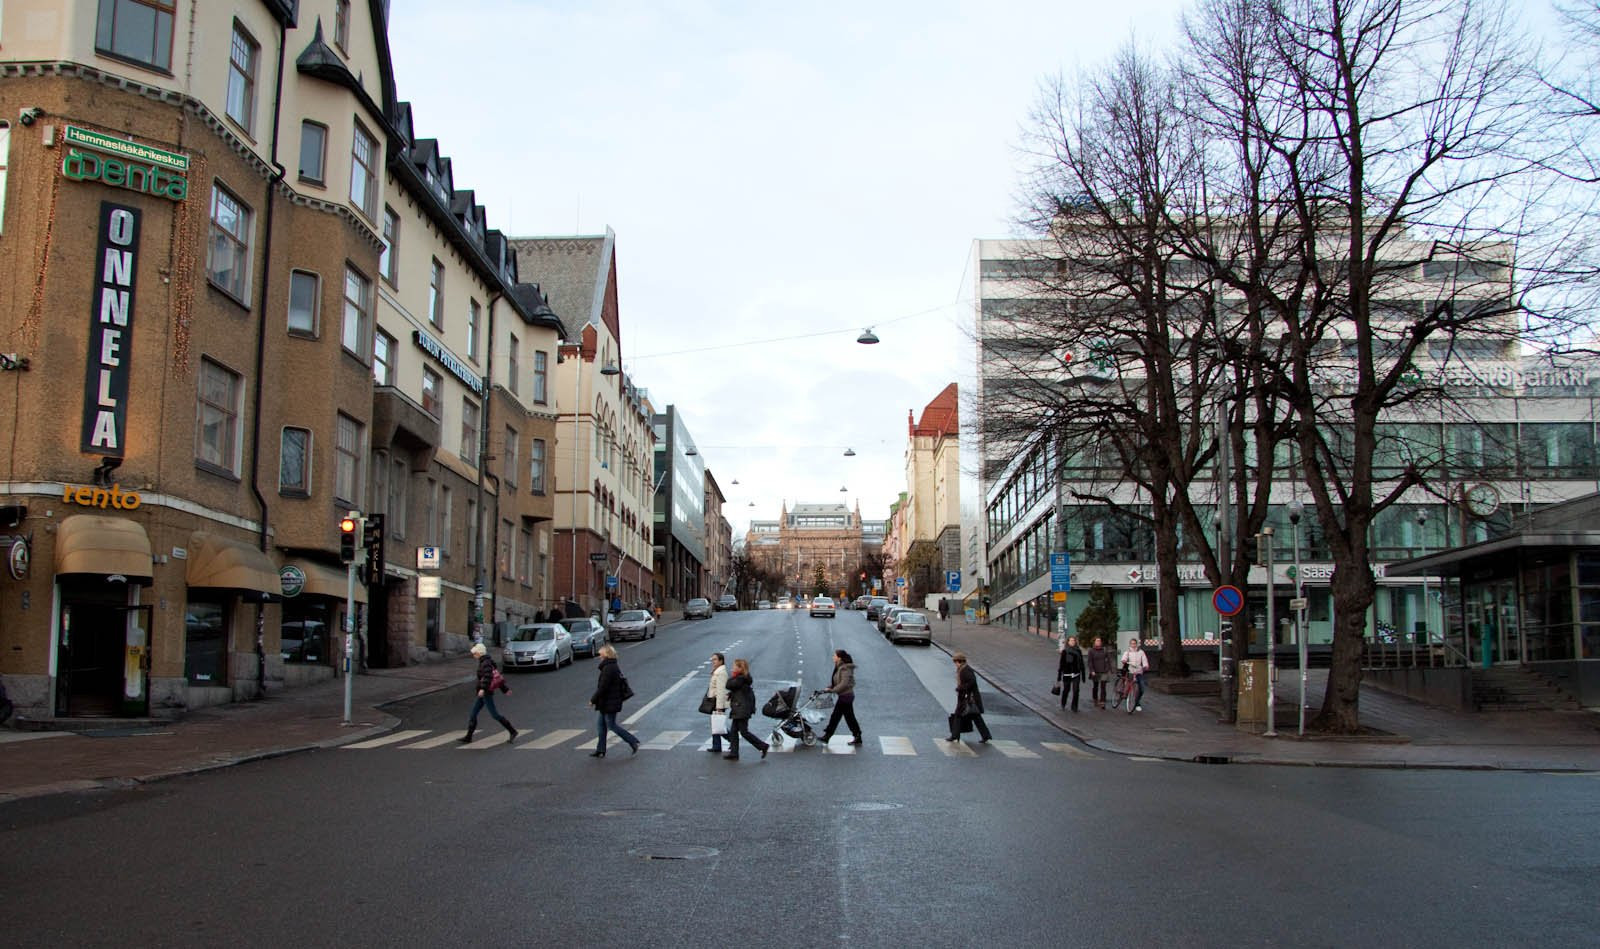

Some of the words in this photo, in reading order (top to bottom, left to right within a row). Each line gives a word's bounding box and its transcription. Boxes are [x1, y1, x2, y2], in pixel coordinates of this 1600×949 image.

[91, 208, 135, 450] ONNELA
[63, 483, 142, 510] rento
[950, 572, 960, 585] P
